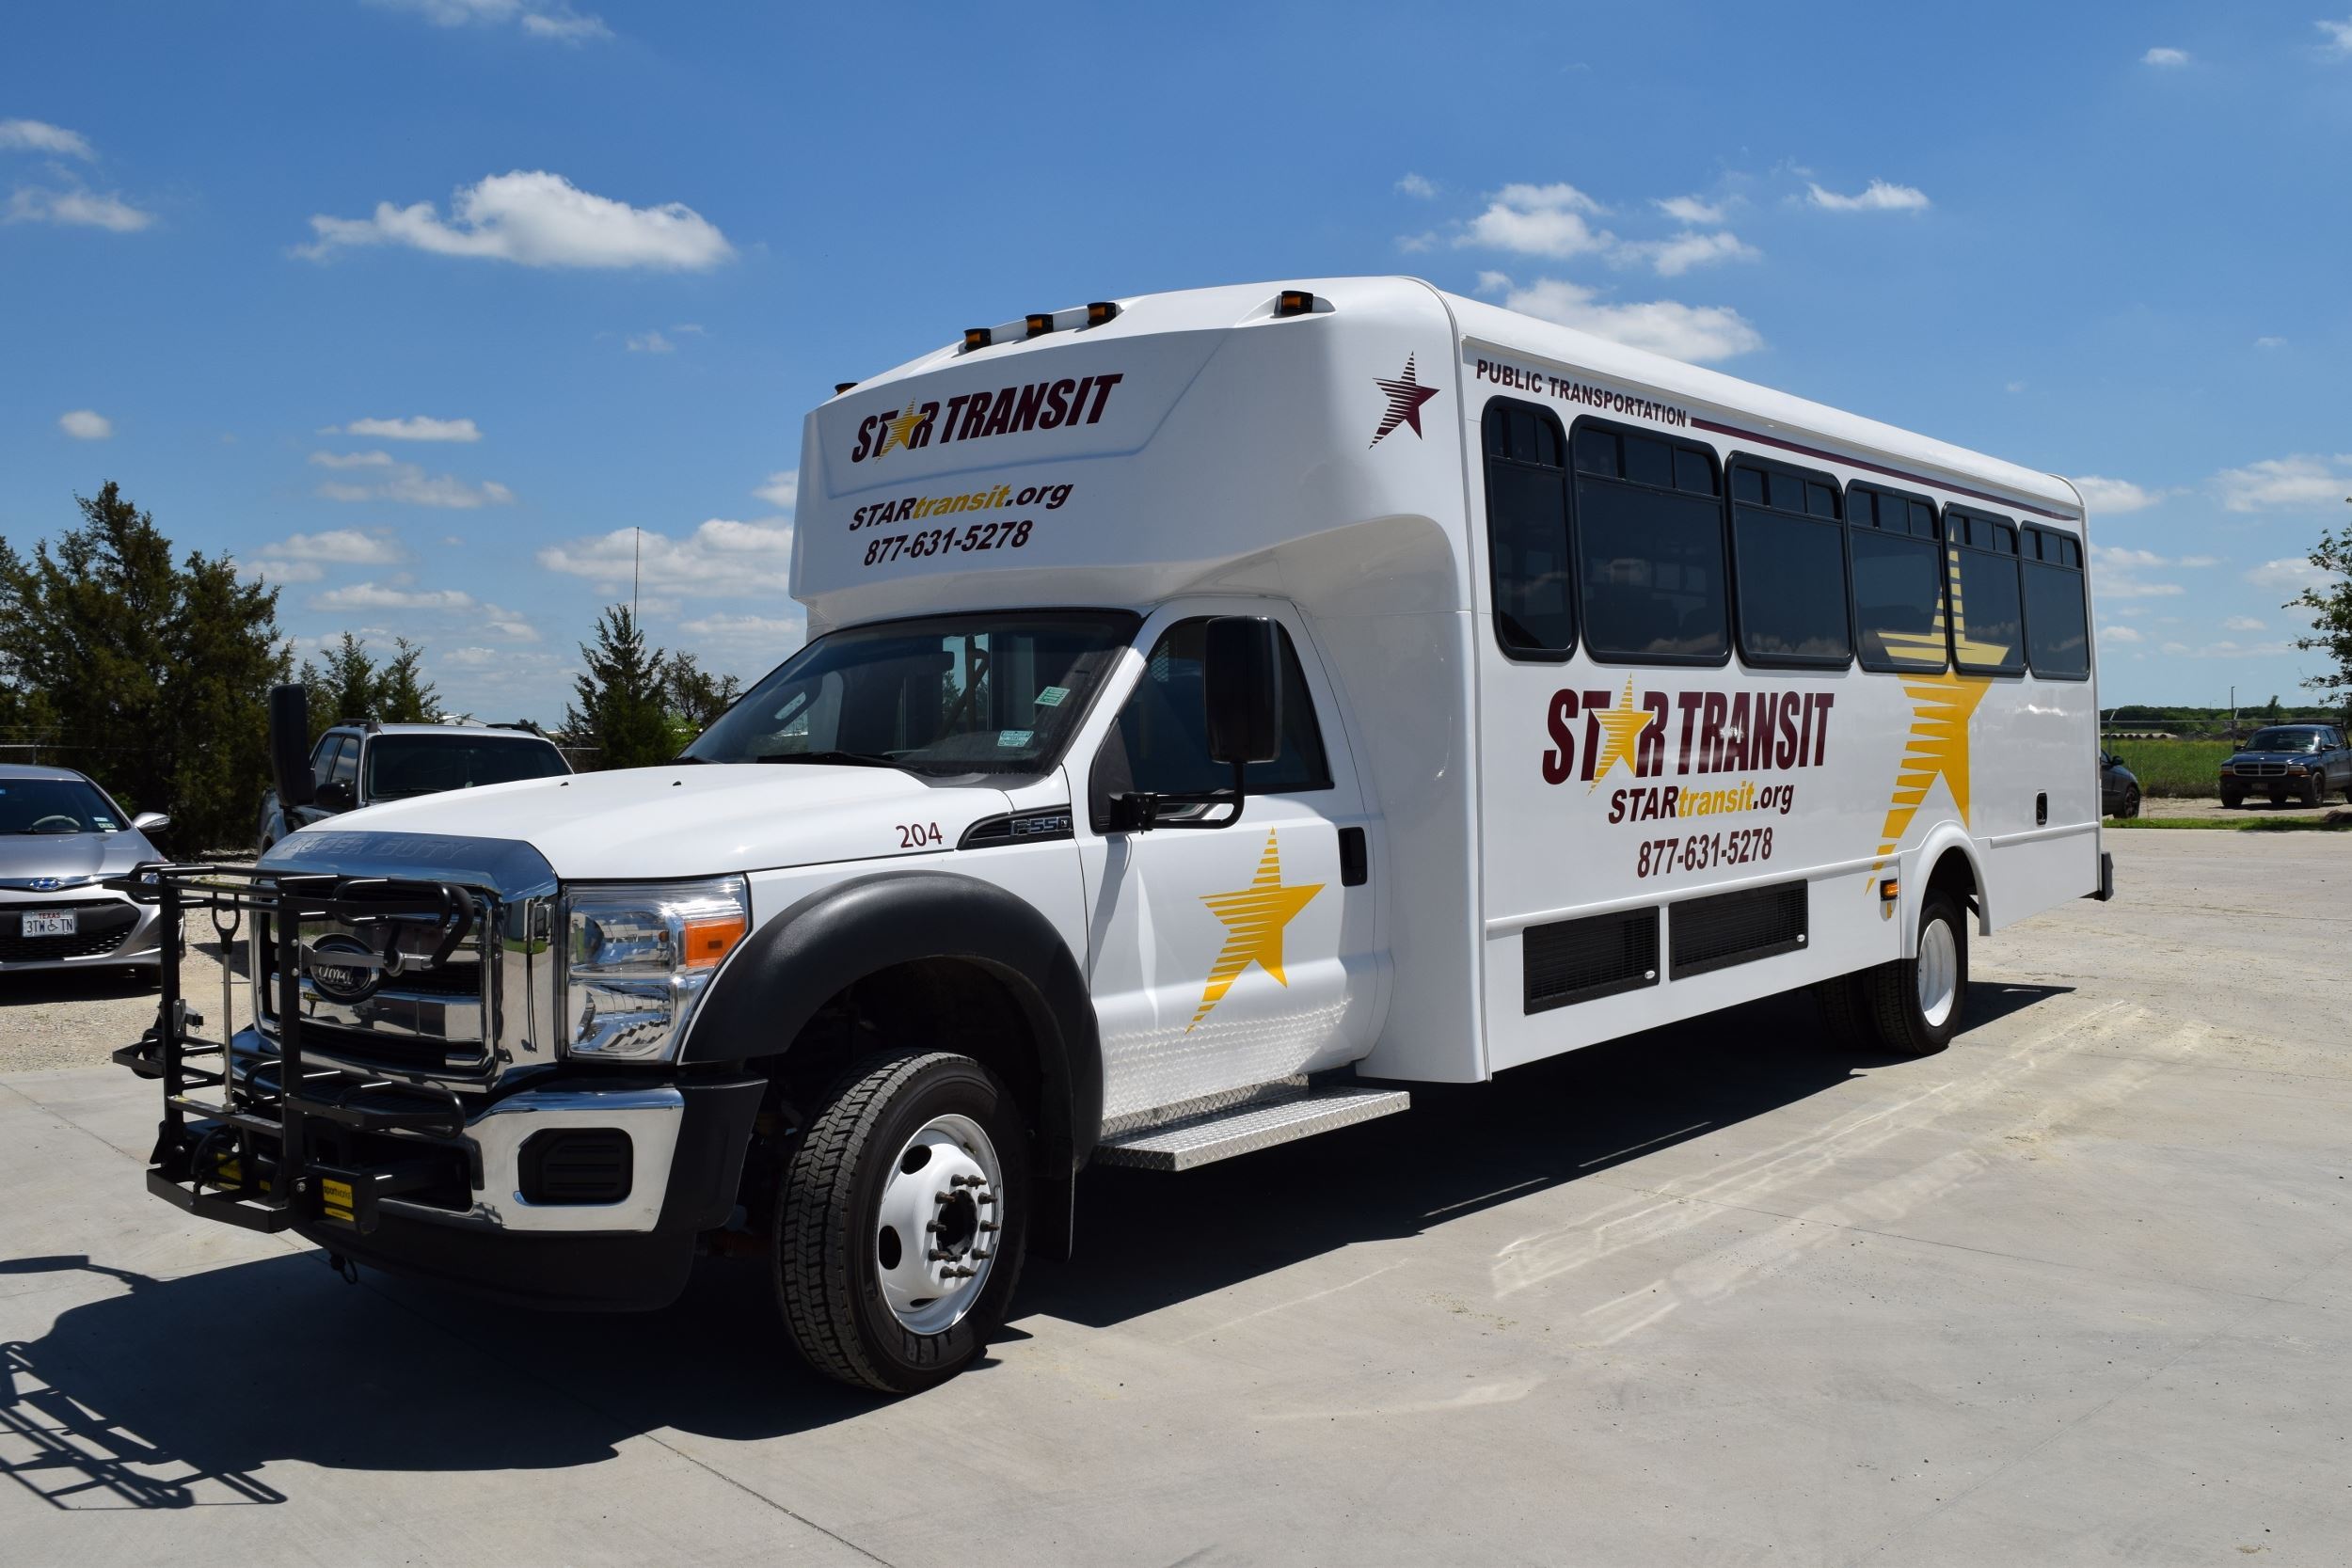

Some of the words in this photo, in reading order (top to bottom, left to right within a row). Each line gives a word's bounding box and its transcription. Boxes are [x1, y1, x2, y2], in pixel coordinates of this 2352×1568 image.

[940, 373, 1123, 444] TRANSIT
[1476, 358, 1542, 393] PUBLIC
[1549, 377, 1686, 427] TRANSPORTATION
[850, 483, 1073, 531] STARtransit.org
[864, 520, 1033, 566] 877-631-5278
[1677, 691, 1835, 775] TRANSIT
[1609, 781, 1794, 824] STARtransit.org
[895, 821, 943, 848] 204
[1637, 827, 1772, 879] 877-631-5278
[60, 918, 73, 931] TN
